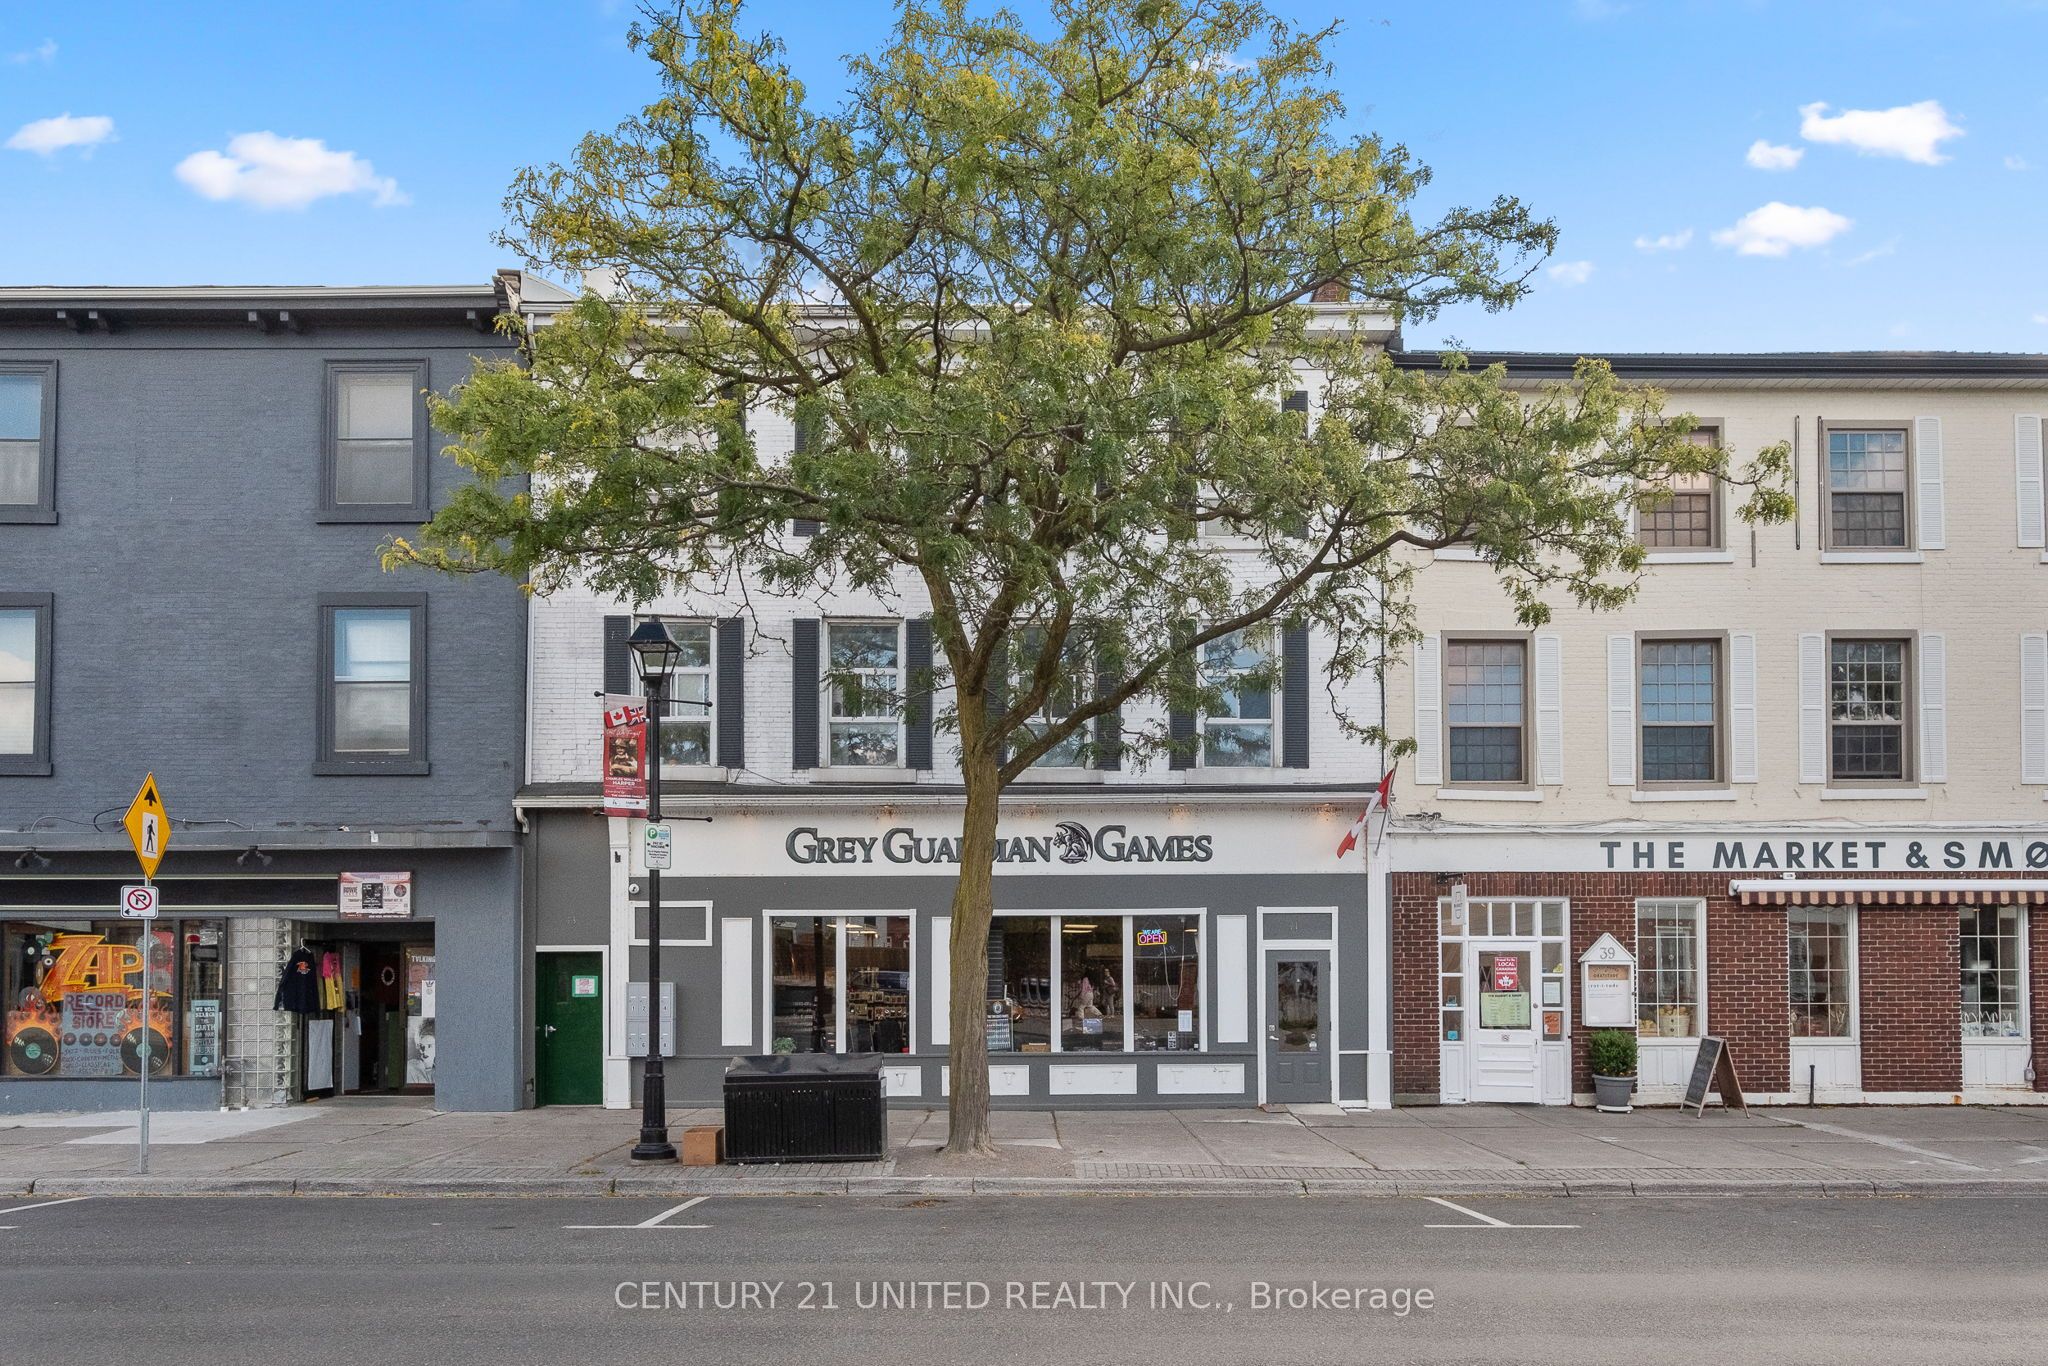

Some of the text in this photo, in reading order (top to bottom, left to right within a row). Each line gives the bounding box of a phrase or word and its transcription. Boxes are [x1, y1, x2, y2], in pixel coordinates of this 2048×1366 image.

[1600, 841, 1685, 869] THE
[1712, 841, 1886, 869] MARKET
[1140, 934, 1165, 944] OPEN
[1600, 946, 1616, 960] 39
[39, 931, 158, 1003] ZAP
[64, 994, 125, 1012] RECORD
[72, 1011, 116, 1030] STORE
